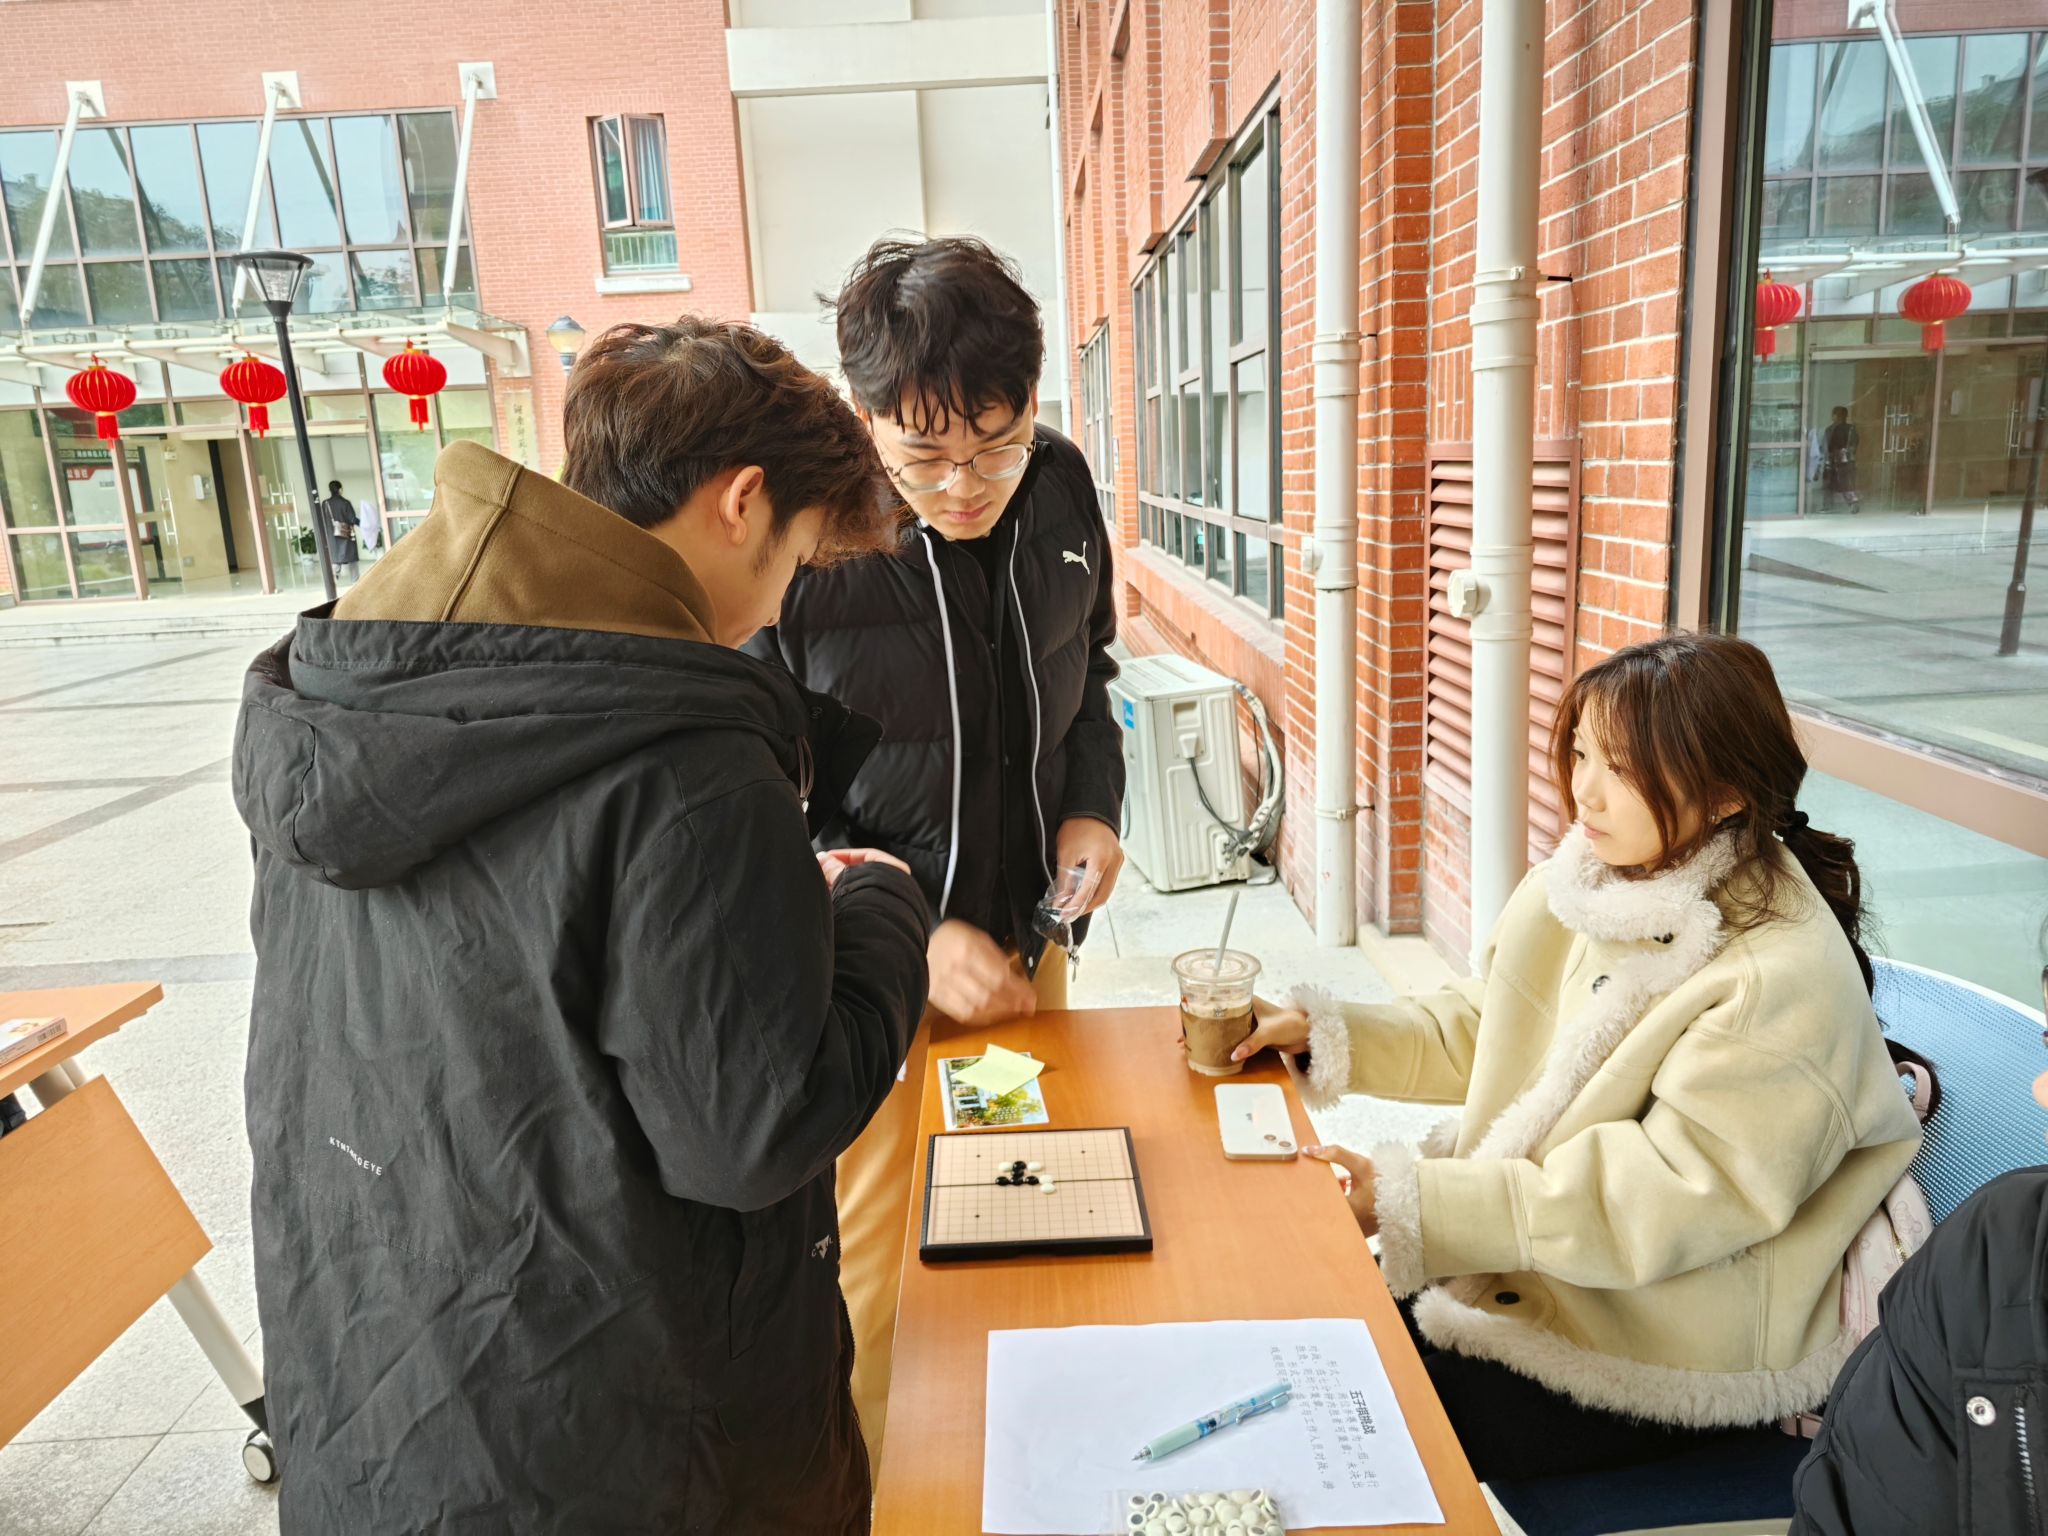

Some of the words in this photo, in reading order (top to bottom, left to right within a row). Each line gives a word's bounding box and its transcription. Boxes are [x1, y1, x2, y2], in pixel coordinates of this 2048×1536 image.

[1349, 1389, 1377, 1435] 五子棋挑战
